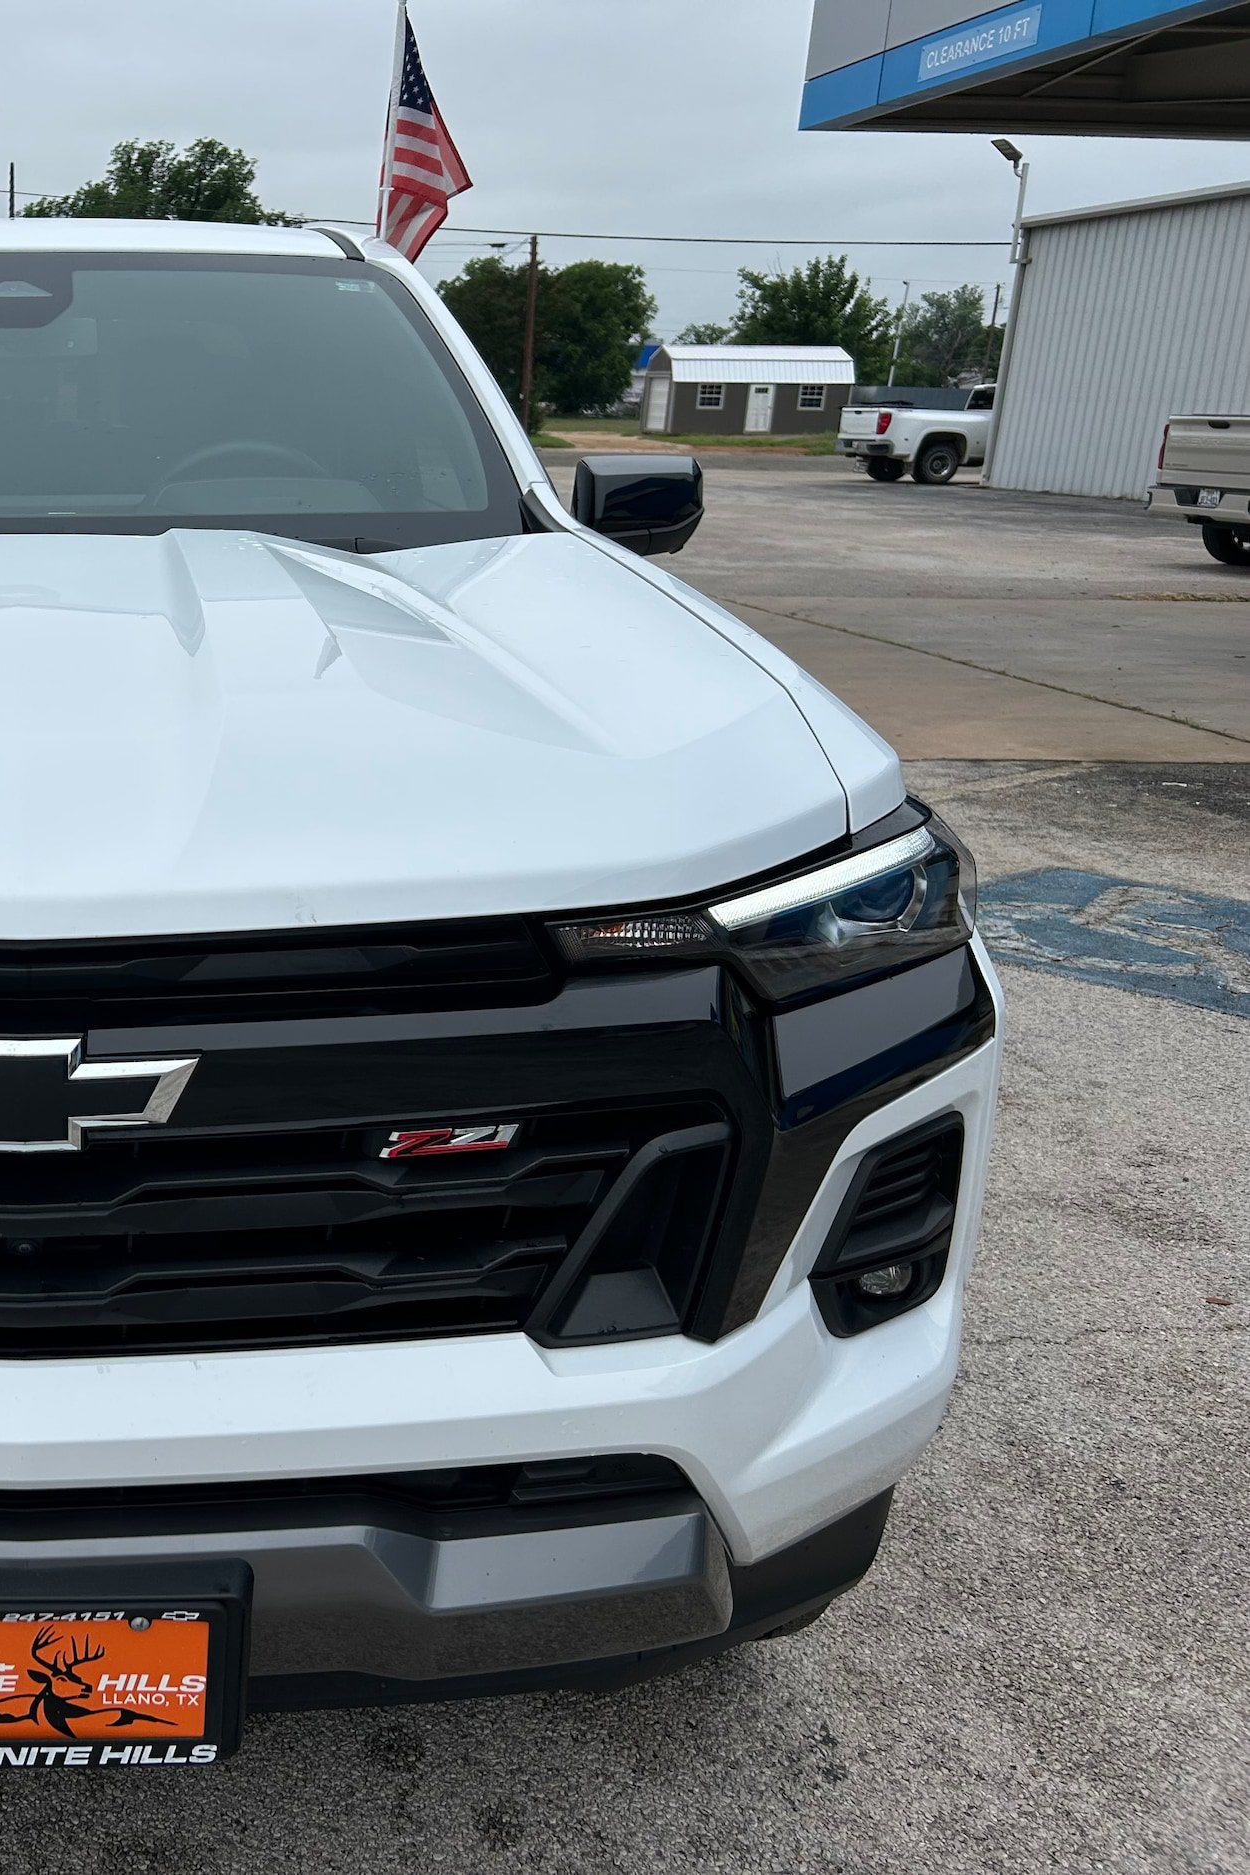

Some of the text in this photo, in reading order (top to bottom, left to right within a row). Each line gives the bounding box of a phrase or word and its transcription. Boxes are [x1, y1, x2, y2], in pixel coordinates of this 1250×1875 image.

[927, 17, 1031, 69] CLEARANCE 10 FT
[379, 1124, 519, 1158] Z71
[97, 1673, 207, 1692] HILLS
[102, 1693, 199, 1707] LLANO, TX
[99, 1744, 217, 1766] HILLS
